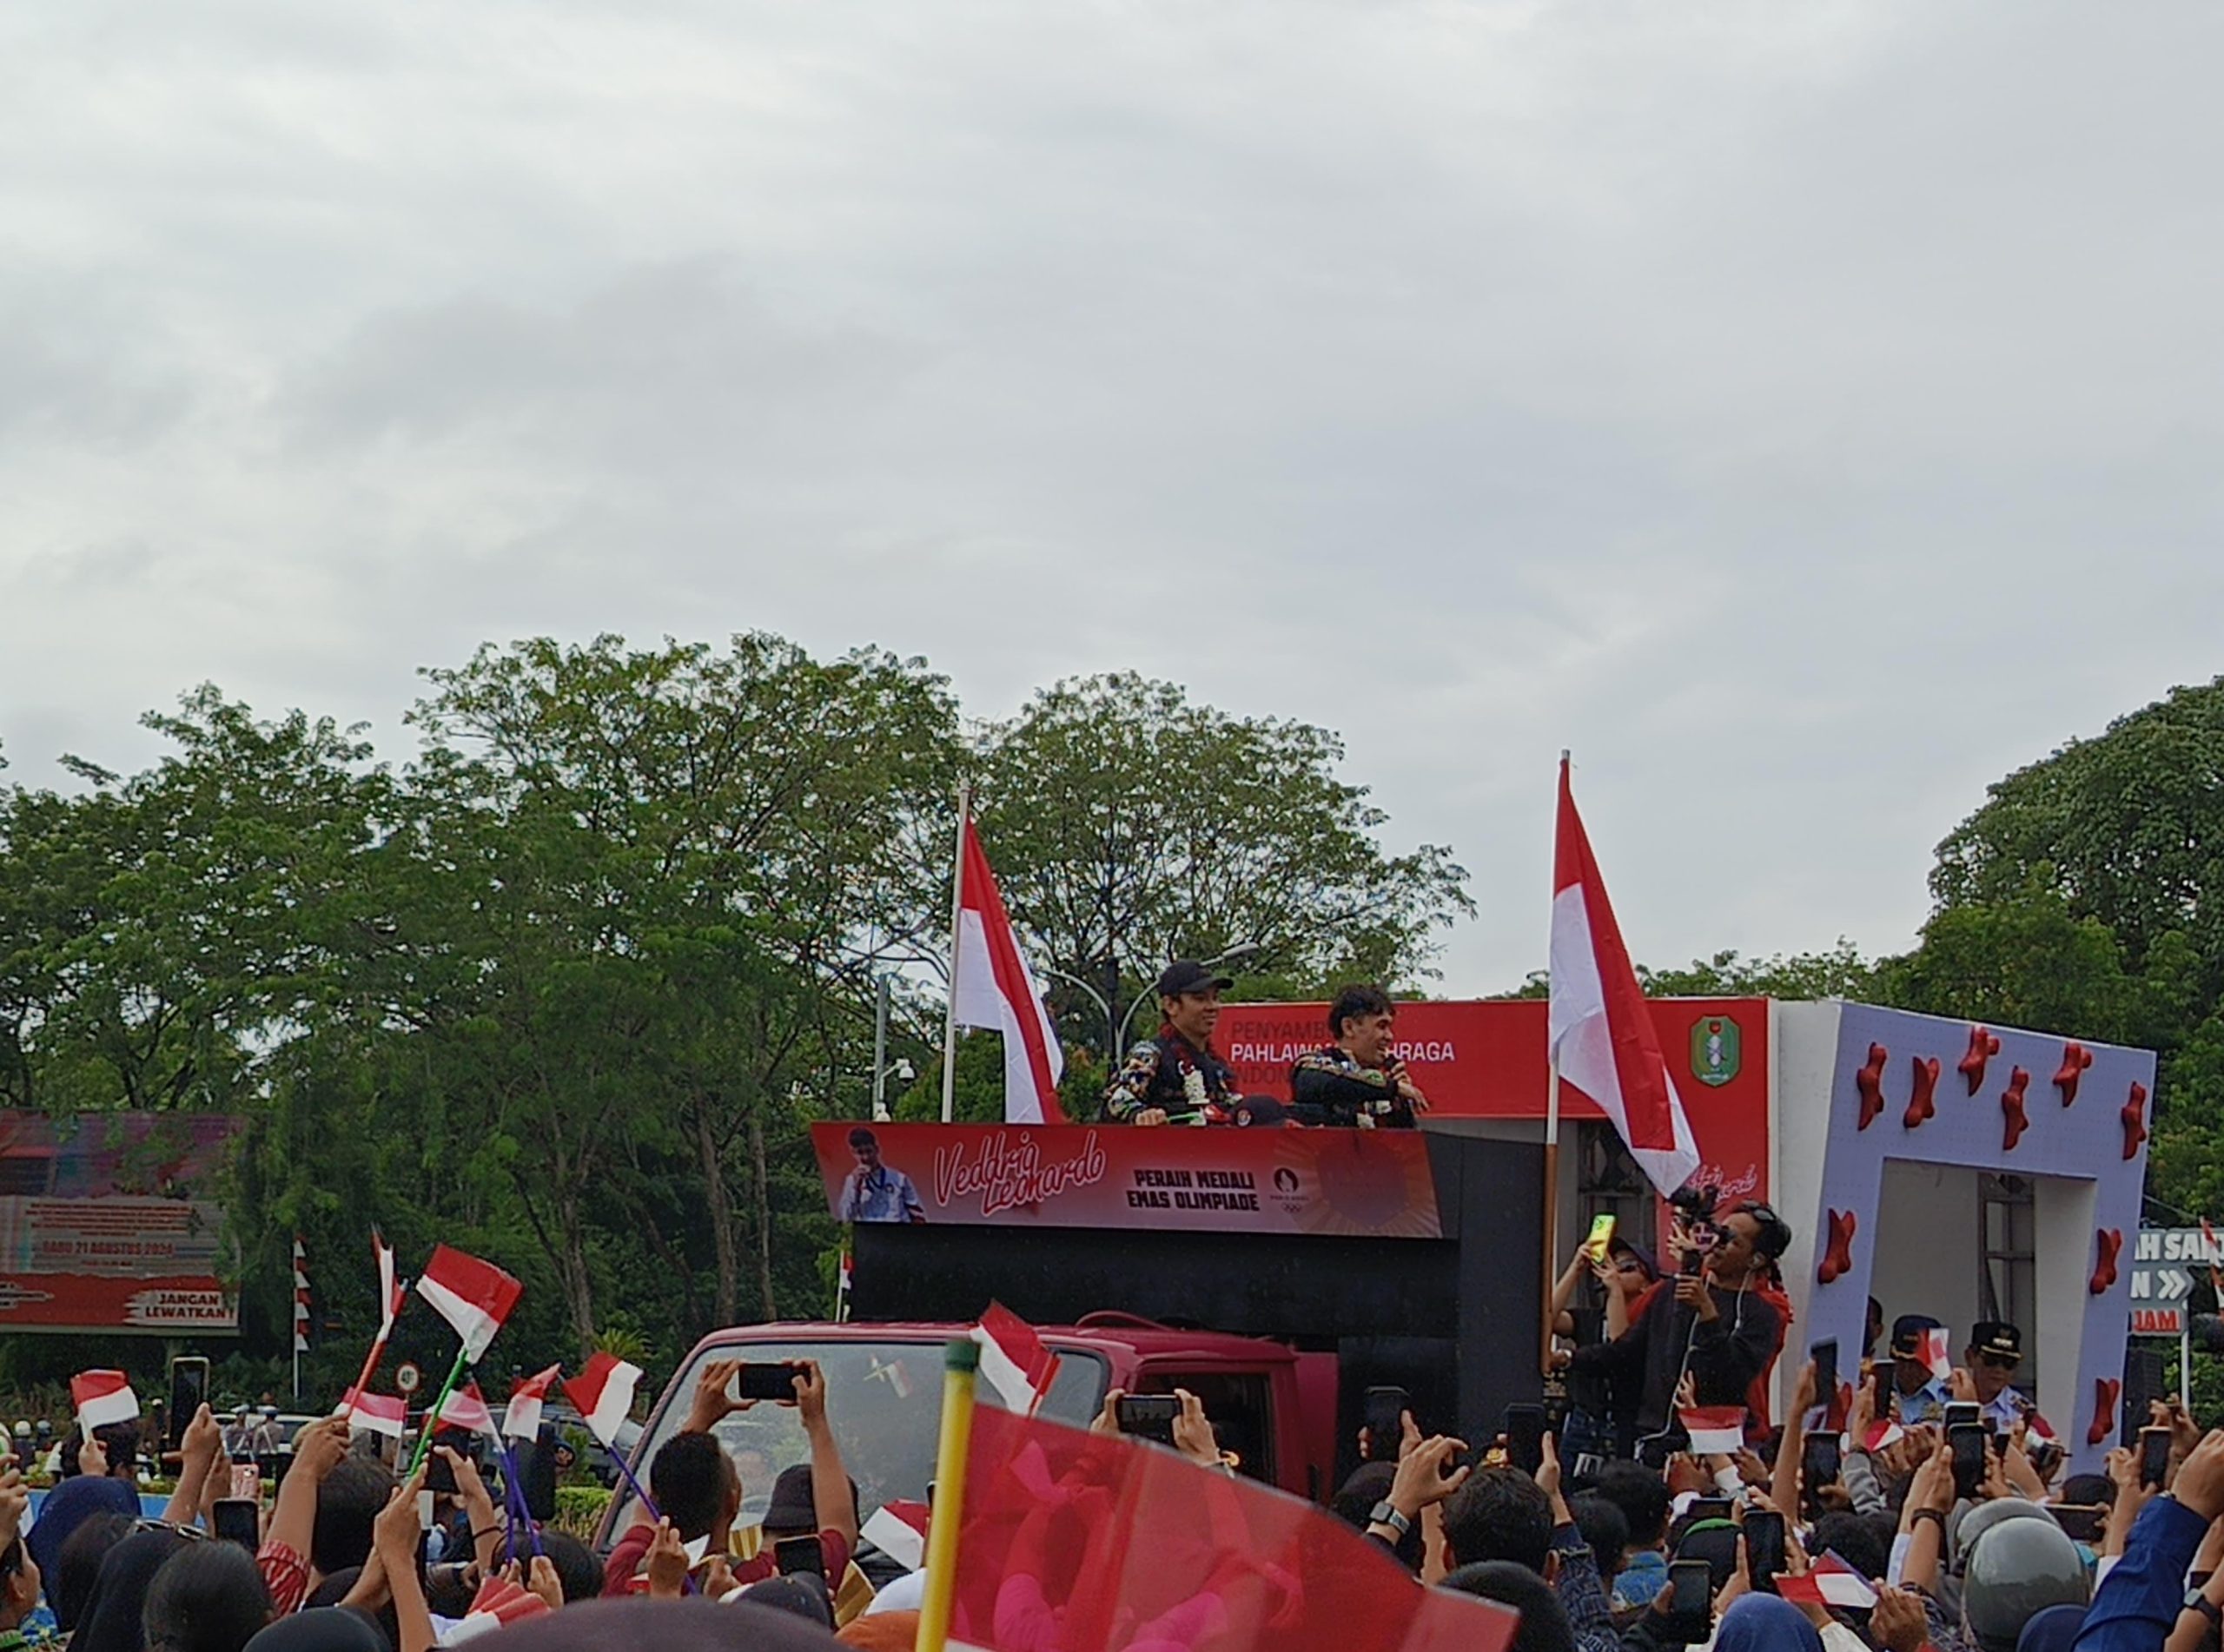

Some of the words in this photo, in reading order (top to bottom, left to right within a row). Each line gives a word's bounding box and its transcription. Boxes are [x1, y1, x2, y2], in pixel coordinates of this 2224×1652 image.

[1230, 1043, 1340, 1062] PAHLAW
[981, 1129, 1107, 1217] Leonardo
[1133, 1169, 1193, 1188] PERAIH
[1197, 1170, 1256, 1190] MEDALI
[1126, 1190, 1171, 1209] EMAS
[1175, 1191, 1261, 1212] OLIMPIADE
[159, 1293, 219, 1305] JANGAN
[2134, 1309, 2181, 1332] JAM
